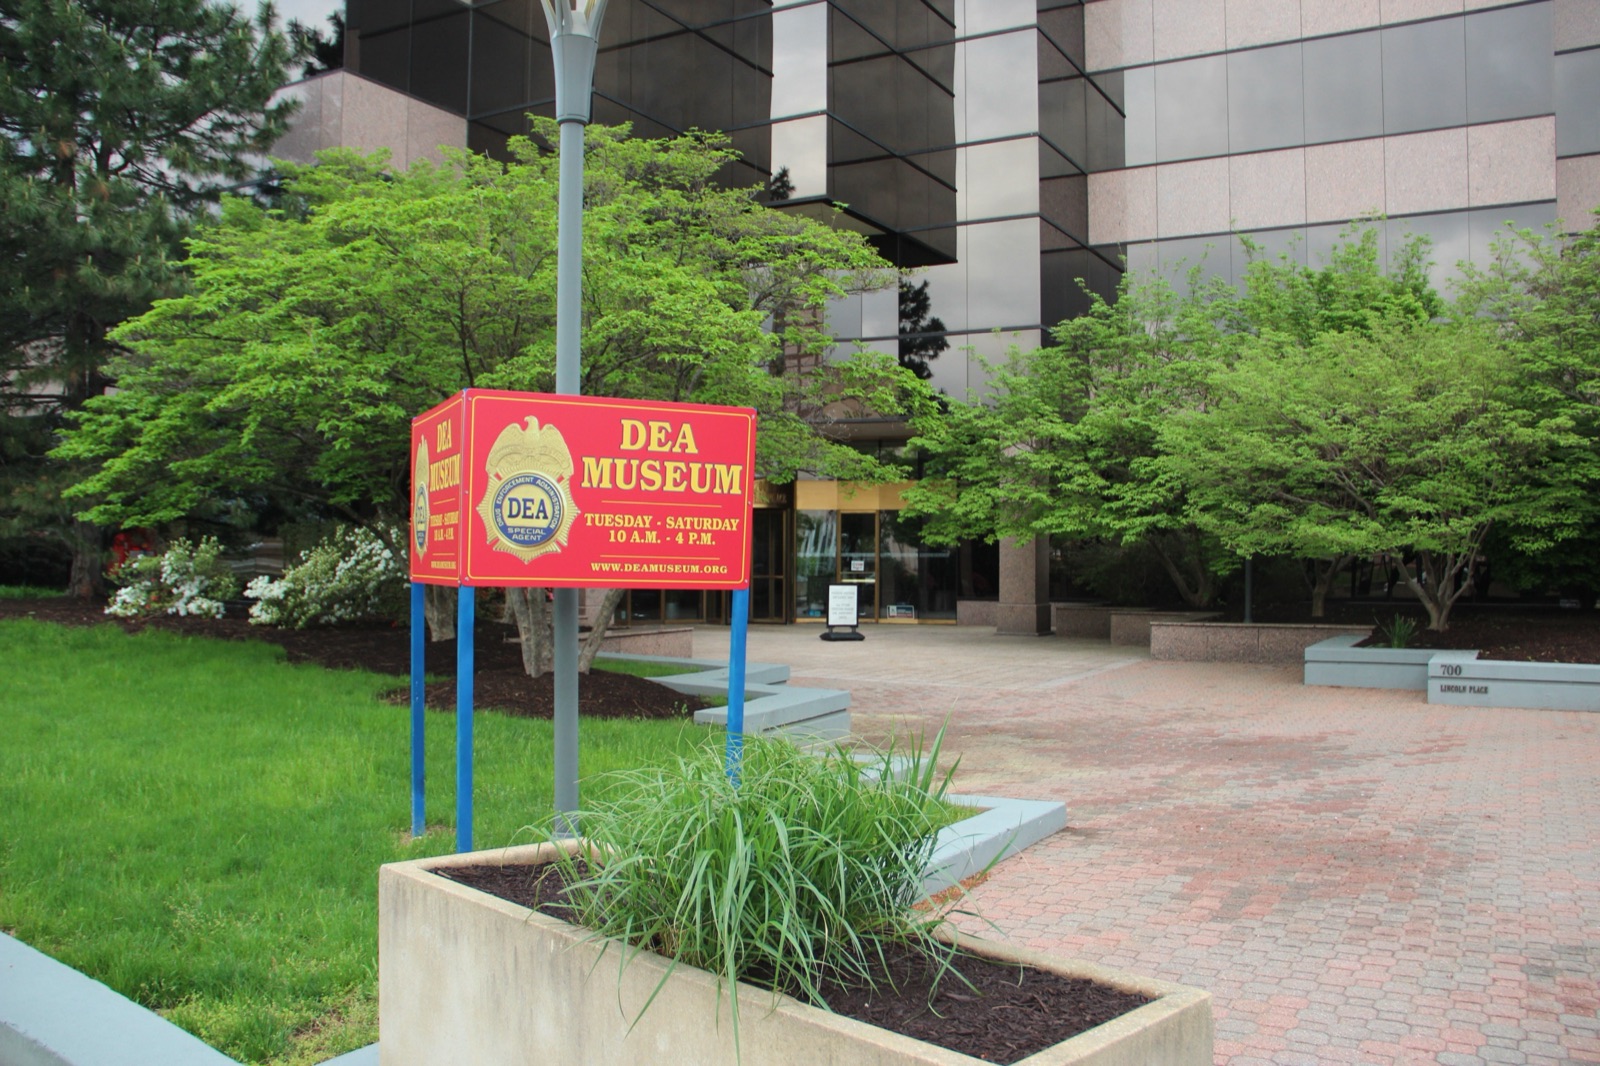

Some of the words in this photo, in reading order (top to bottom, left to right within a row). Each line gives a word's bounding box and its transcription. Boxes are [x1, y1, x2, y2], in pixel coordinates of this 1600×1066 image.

[436, 418, 452, 453] DEA
[620, 419, 698, 454] DEA
[429, 453, 461, 493] MUSEUM
[581, 456, 743, 496] MUSEUM
[496, 477, 534, 505] ENFORCEMENT
[508, 497, 549, 520] DEA
[536, 479, 560, 529] ADMINISTRATION
[494, 508, 504, 527] DRUG
[584, 513, 652, 529] TUESDAY
[666, 515, 739, 532] SATURDAY
[507, 527, 546, 535] SPECIAL
[608, 531, 626, 543] 10
[630, 531, 661, 544] A.M.
[675, 532, 684, 544] 4
[689, 533, 716, 545] P.M.
[591, 562, 728, 575] WWW.DEAMUSEUM.ORG
[1440, 664, 1462, 676] 700
[1440, 685, 1466, 693] LINCOLN
[1469, 685, 1488, 694] PLACE
